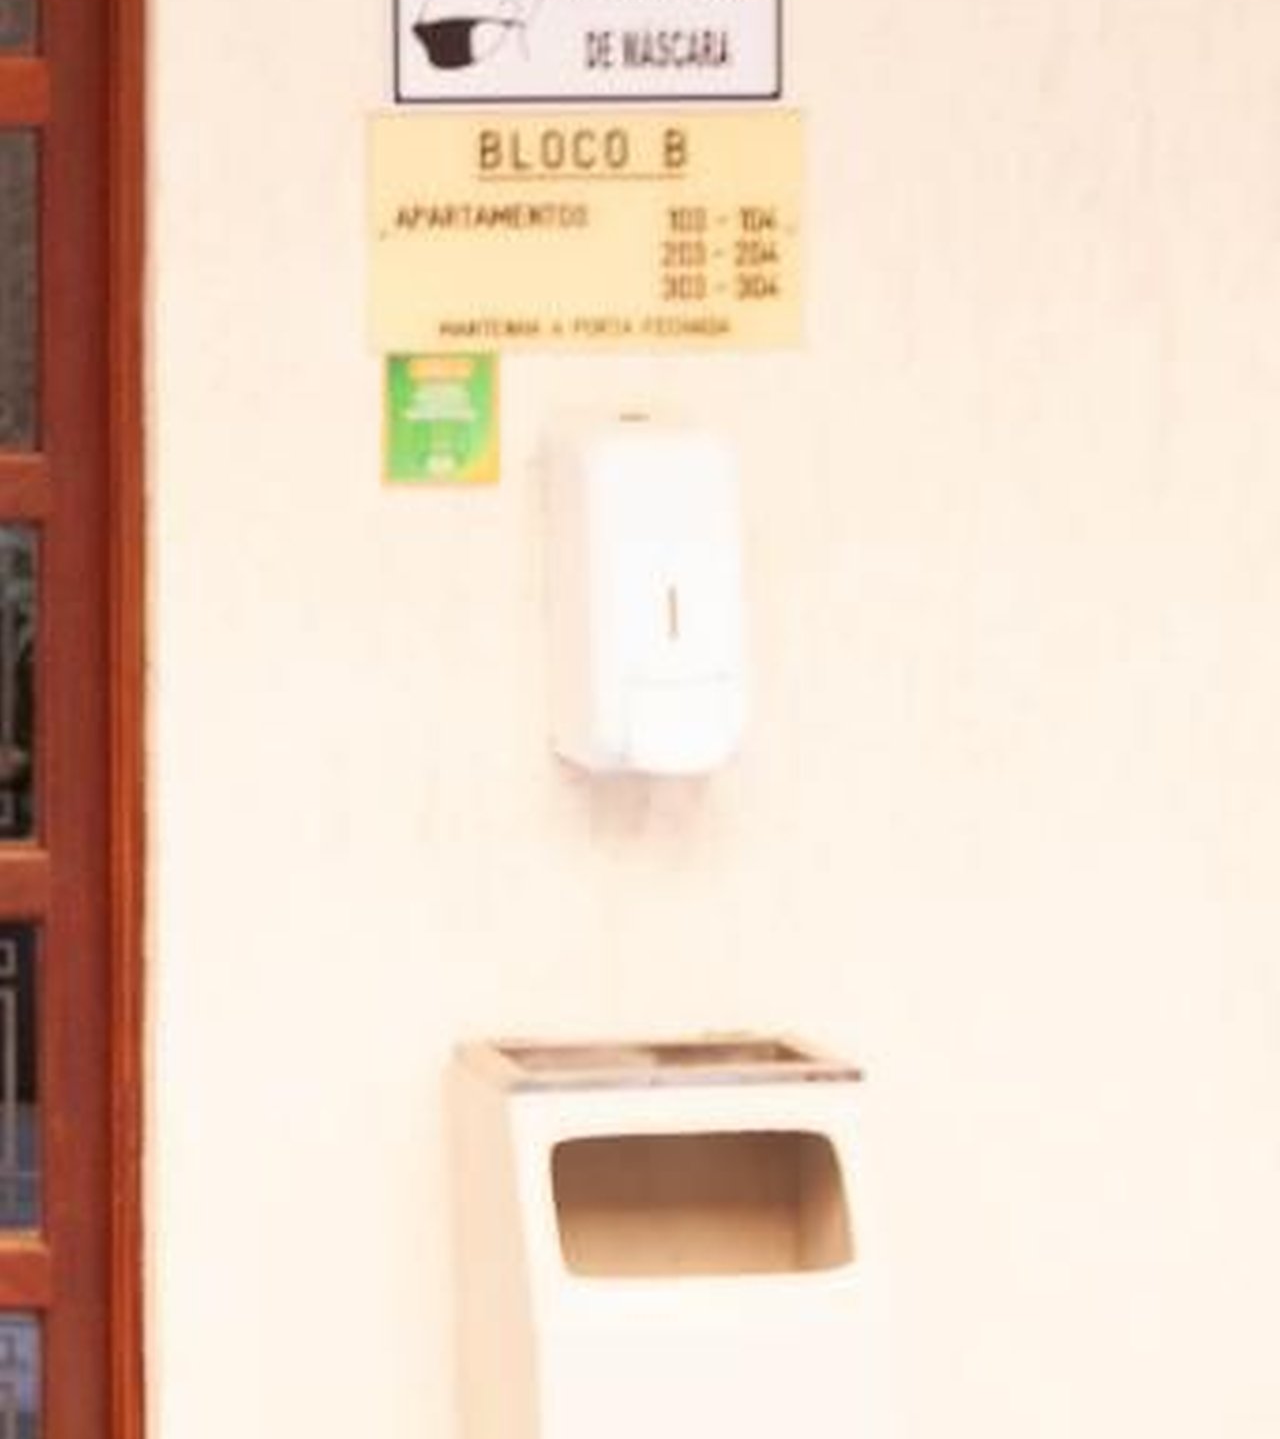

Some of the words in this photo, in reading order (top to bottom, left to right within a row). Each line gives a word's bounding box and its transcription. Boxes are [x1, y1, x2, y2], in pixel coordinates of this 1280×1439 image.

[585, 30, 613, 68] DE
[478, 129, 630, 171] BLOCO
[663, 128, 688, 169] B
[395, 205, 587, 230] APARTAMENTOS
